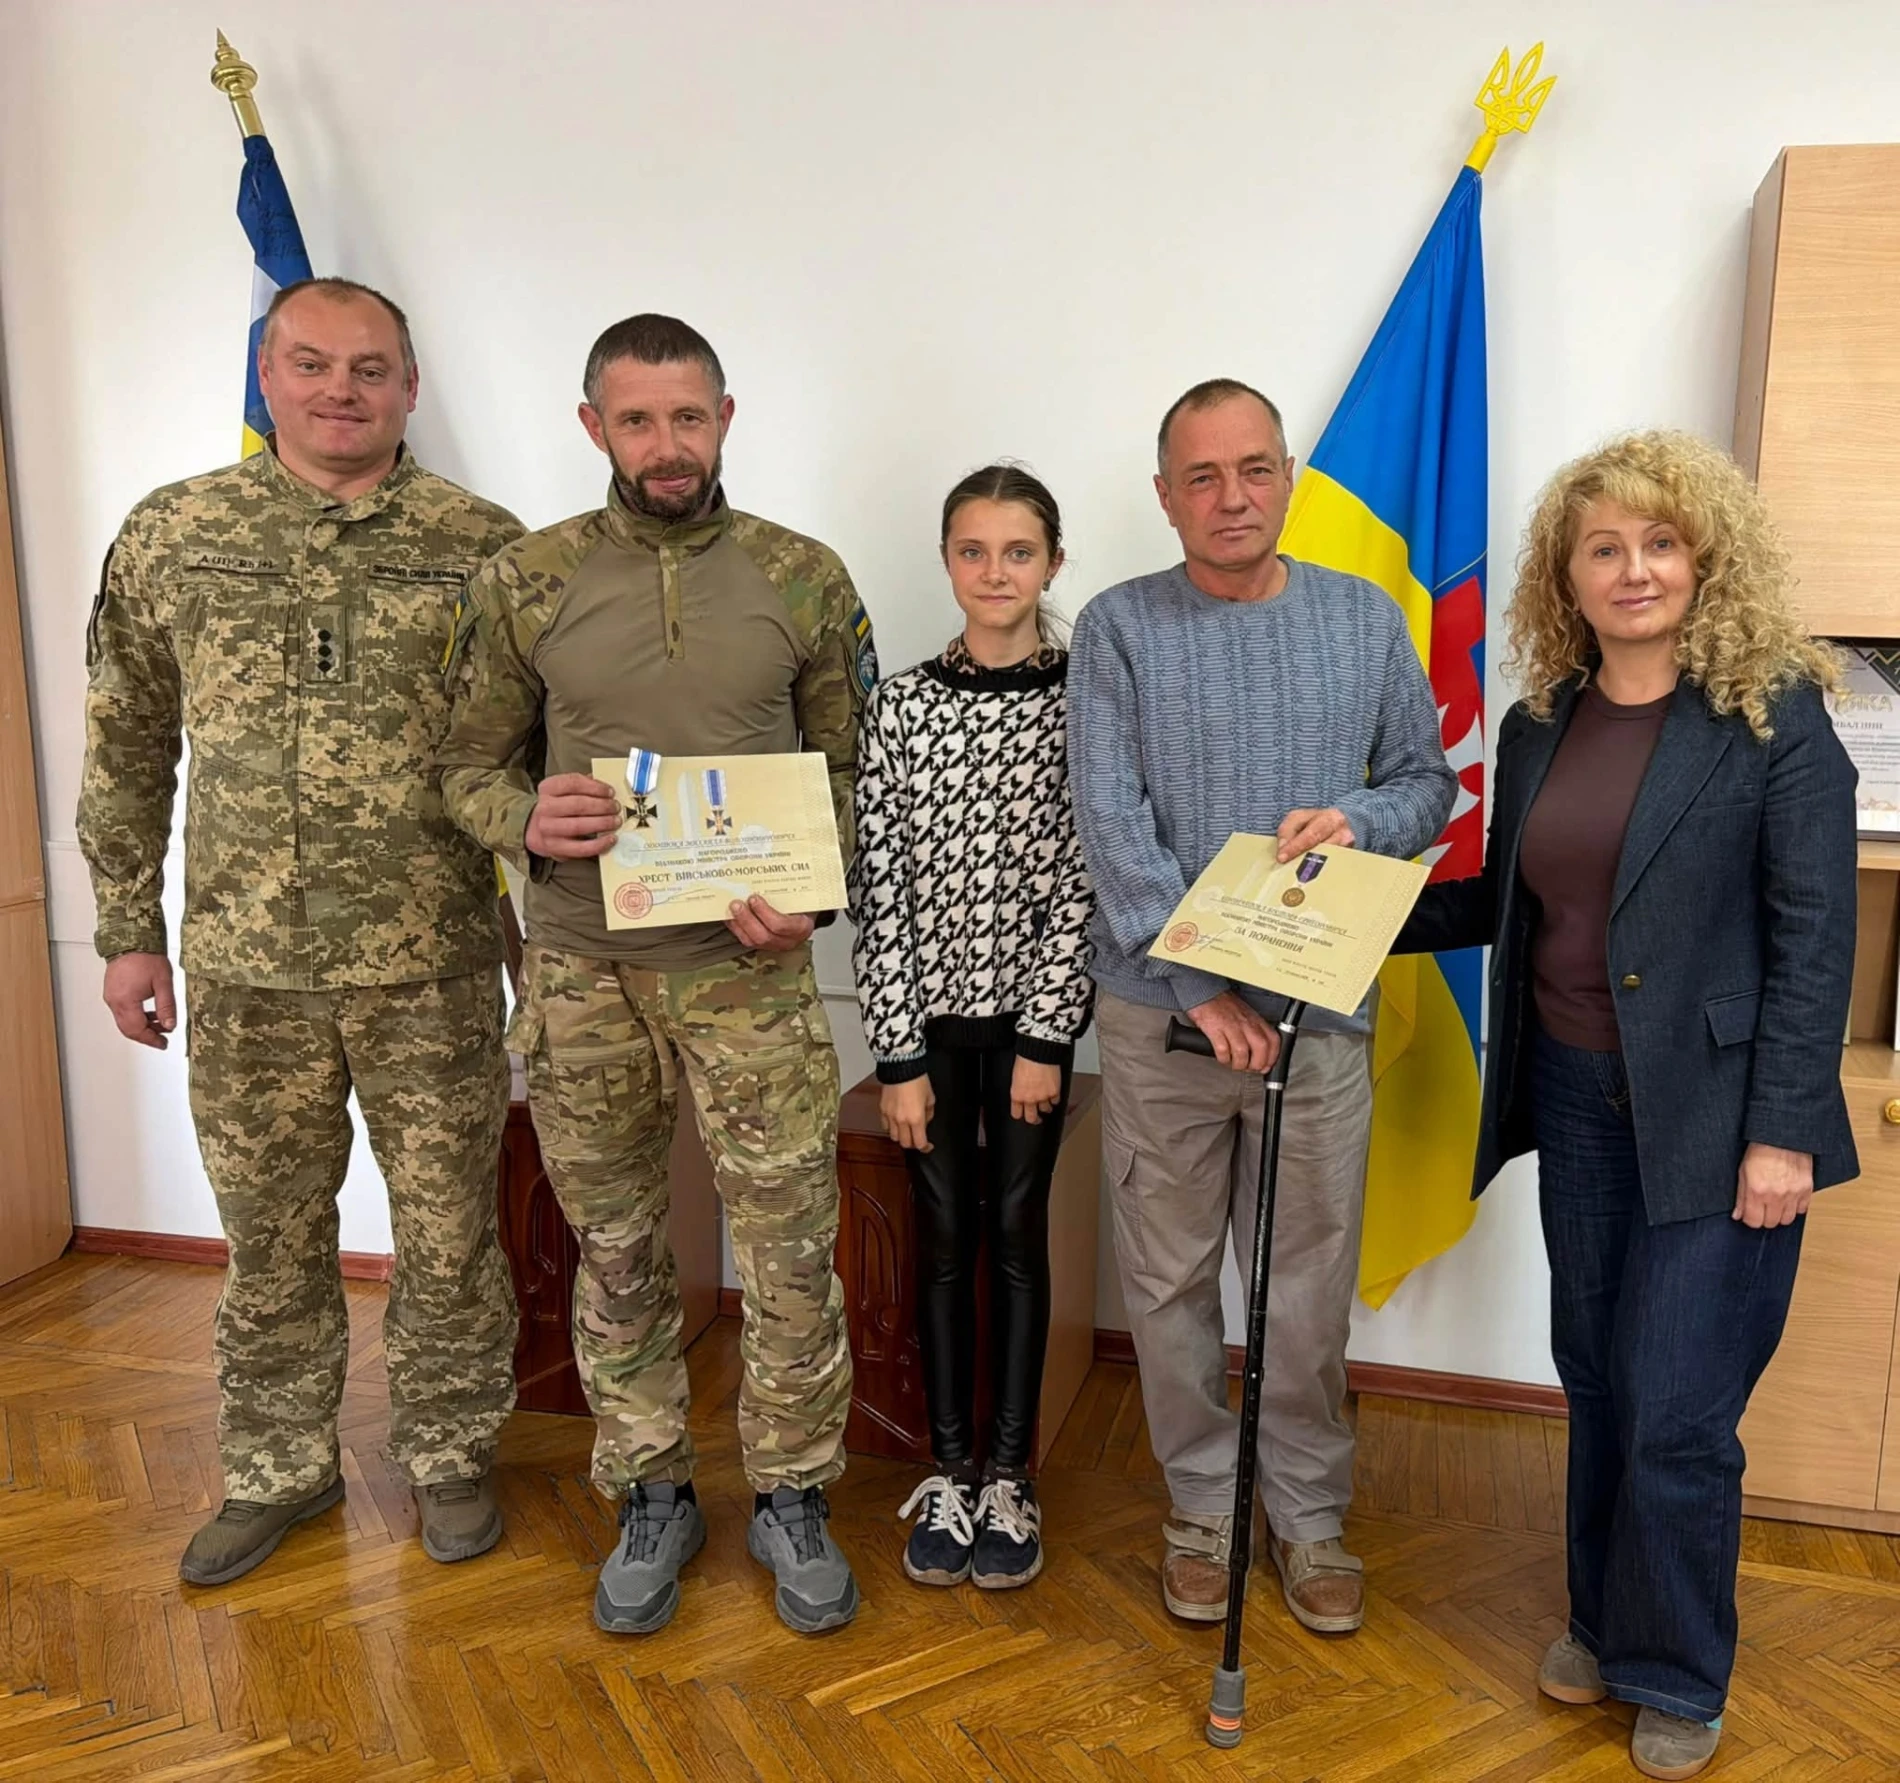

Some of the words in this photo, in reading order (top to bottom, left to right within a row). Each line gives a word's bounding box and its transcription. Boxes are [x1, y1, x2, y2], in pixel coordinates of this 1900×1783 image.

[638, 872, 670, 884] ХРЕСТ
[675, 864, 788, 882] ВІЙСЬКОВО-МОРСЬКИХ
[791, 862, 810, 872] СИЛ
[1234, 926, 1247, 937] ЗА
[1249, 929, 1304, 954] ПОРАНЕННЯ
